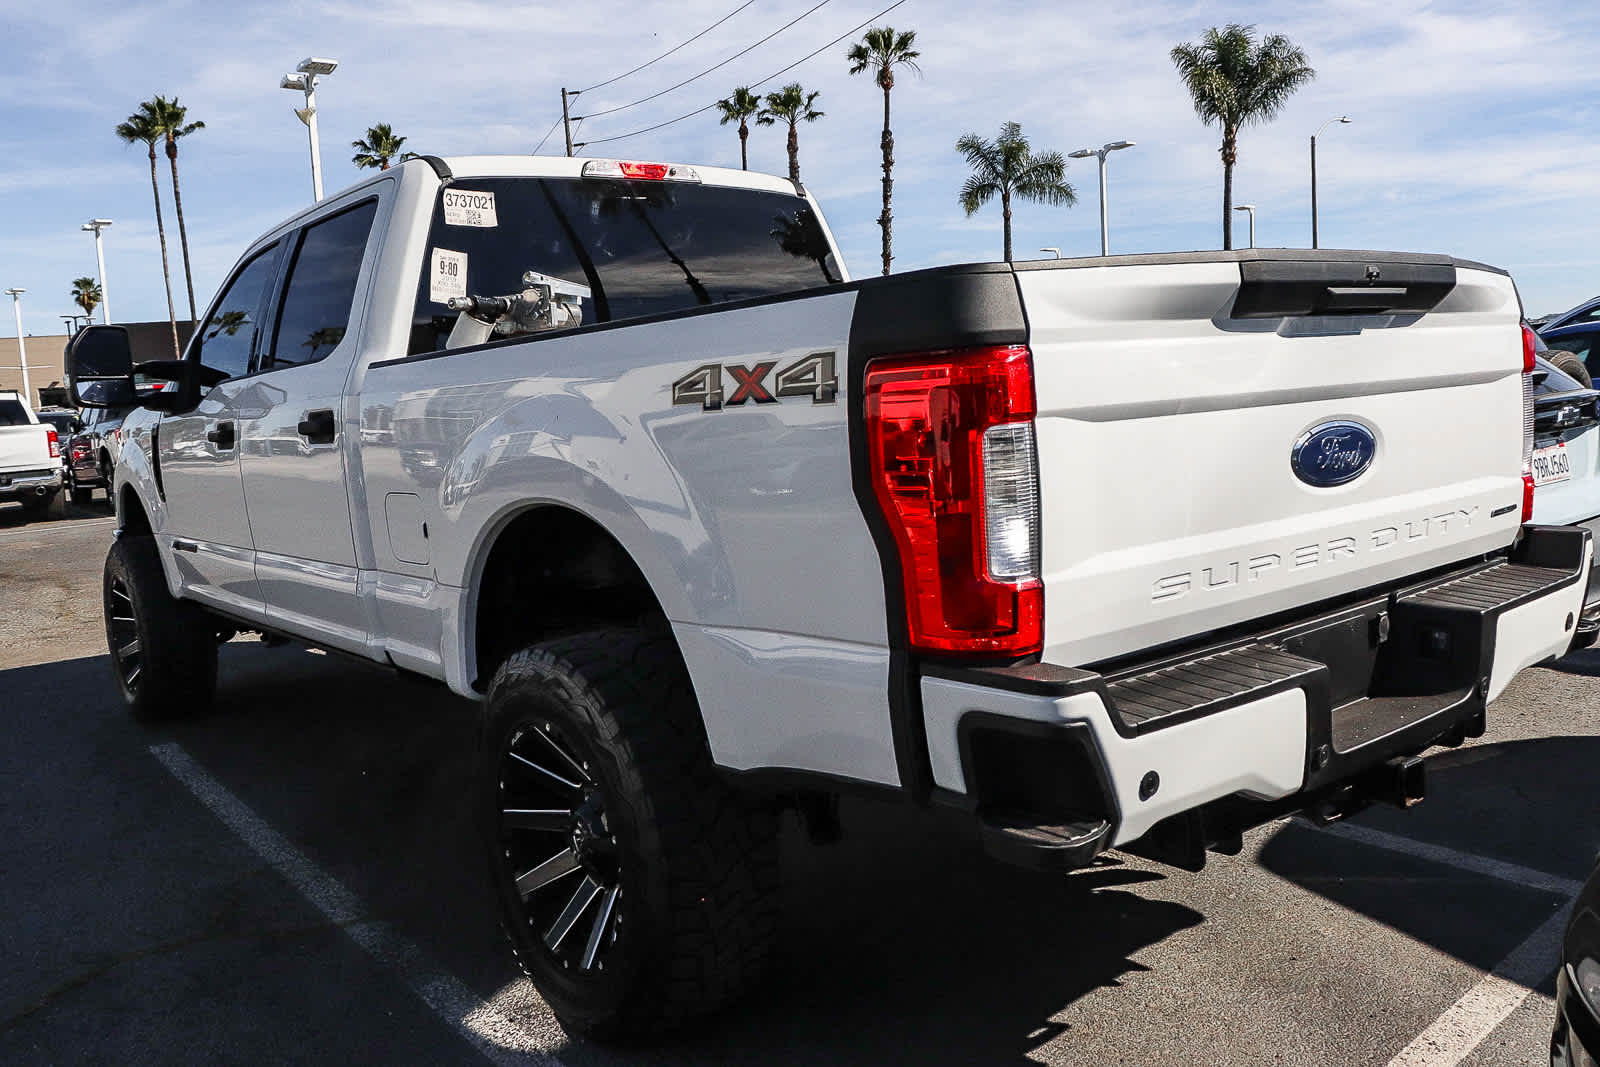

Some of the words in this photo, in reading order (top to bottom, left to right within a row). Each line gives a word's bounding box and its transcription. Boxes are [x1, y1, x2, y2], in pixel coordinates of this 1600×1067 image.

[445, 193, 494, 210] 3737021
[1316, 434, 1362, 471] Ford
[1533, 453, 1570, 480] 9BRJ560
[1151, 535, 1357, 603] SUPER
[1370, 505, 1480, 551] DUTY
